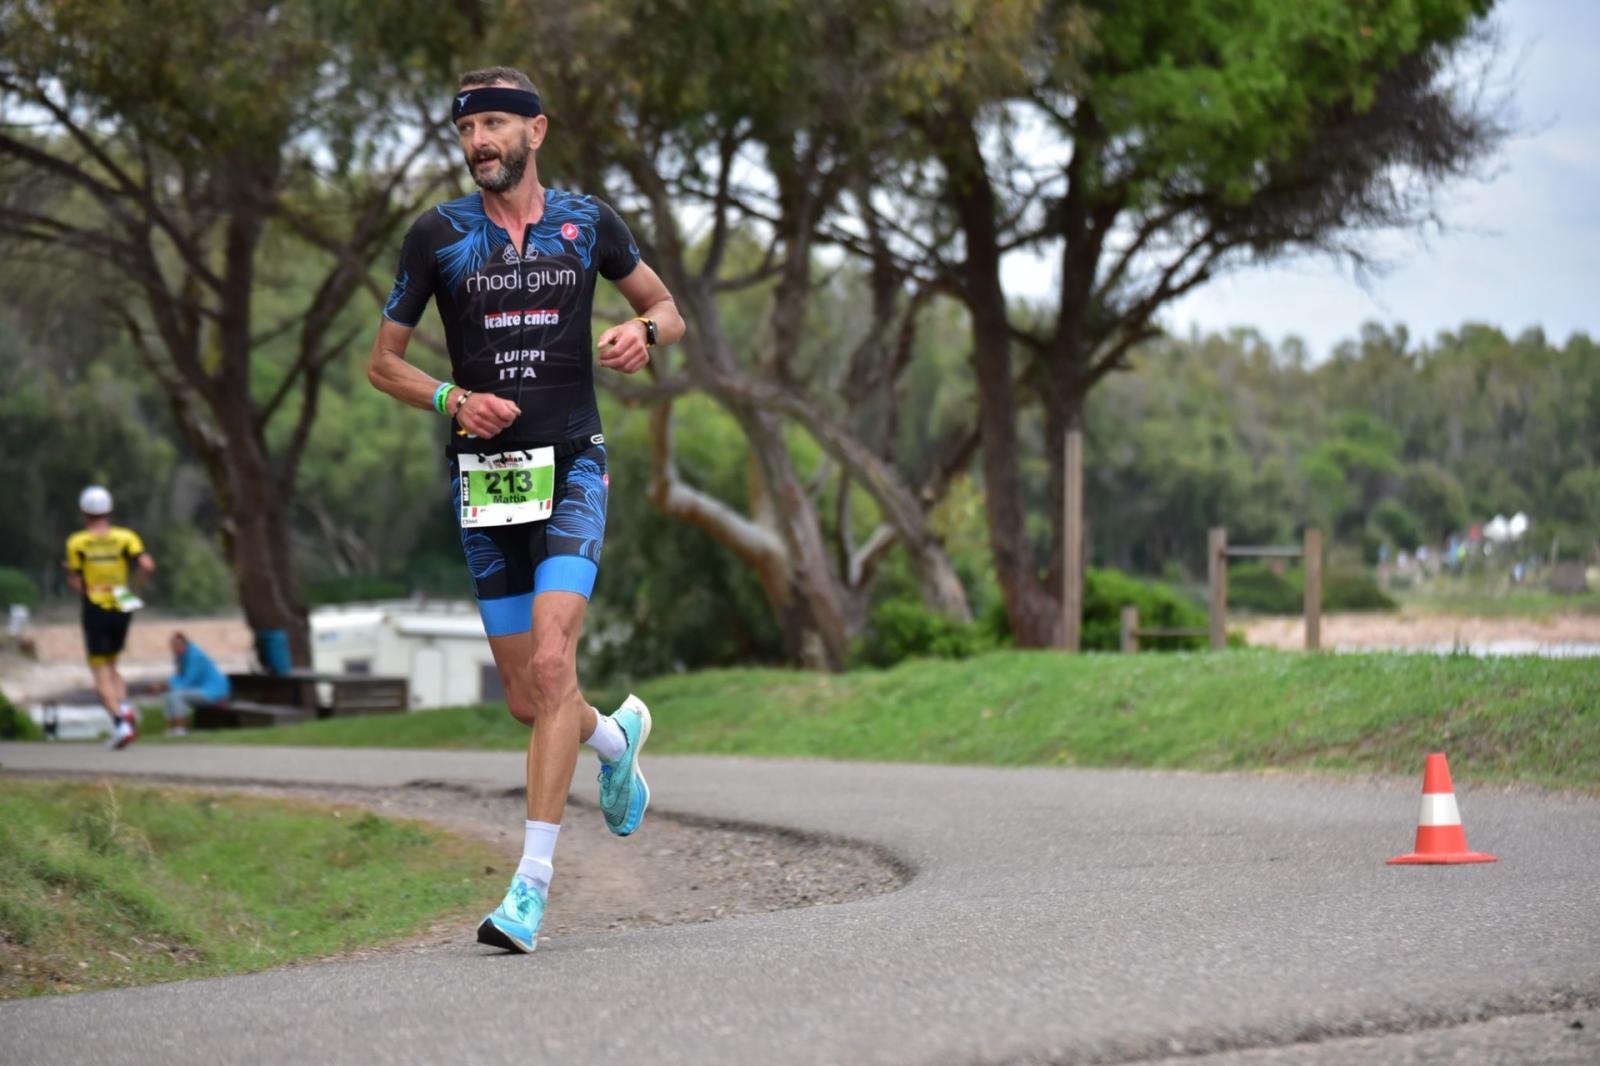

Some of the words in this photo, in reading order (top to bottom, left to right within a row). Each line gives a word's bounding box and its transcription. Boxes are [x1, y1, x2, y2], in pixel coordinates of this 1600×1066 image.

[500, 367, 537, 380] ITA
[485, 470, 533, 494] 213
[493, 493, 527, 504] Mattia
